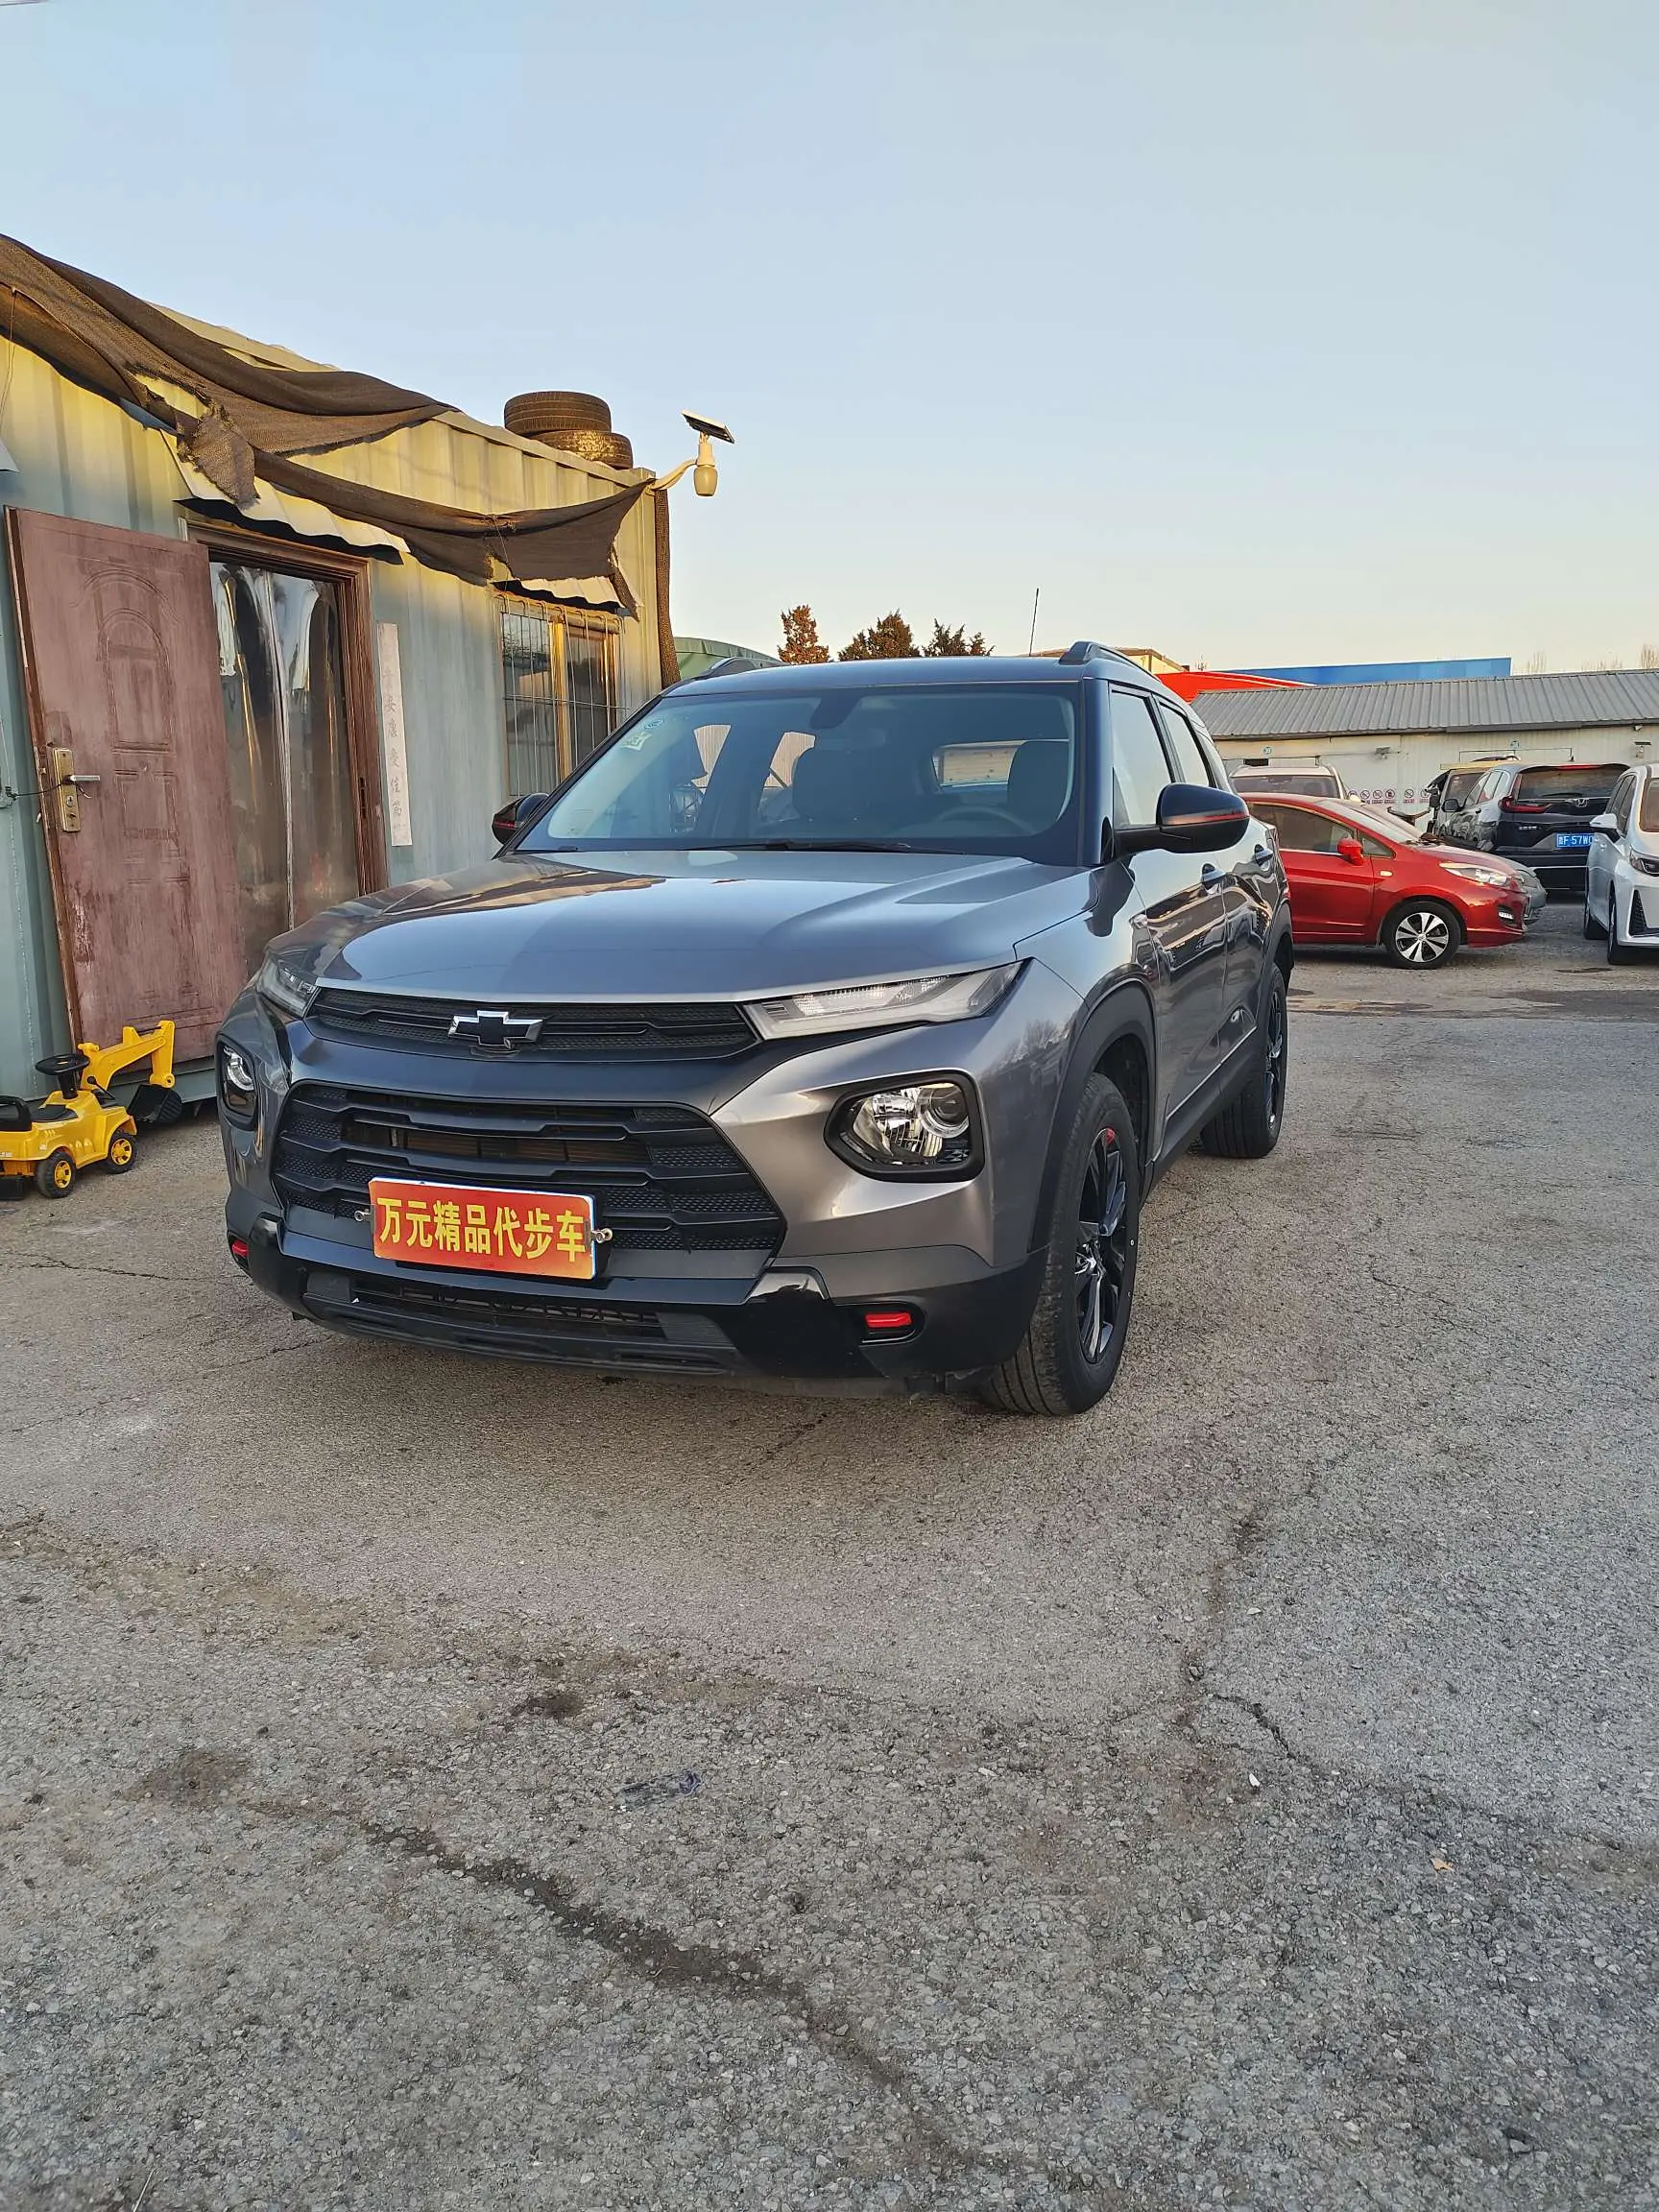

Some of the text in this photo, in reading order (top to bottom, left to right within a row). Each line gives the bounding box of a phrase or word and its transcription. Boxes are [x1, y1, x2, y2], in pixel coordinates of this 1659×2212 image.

[376, 1197, 587, 1262] 万元精品代步车
